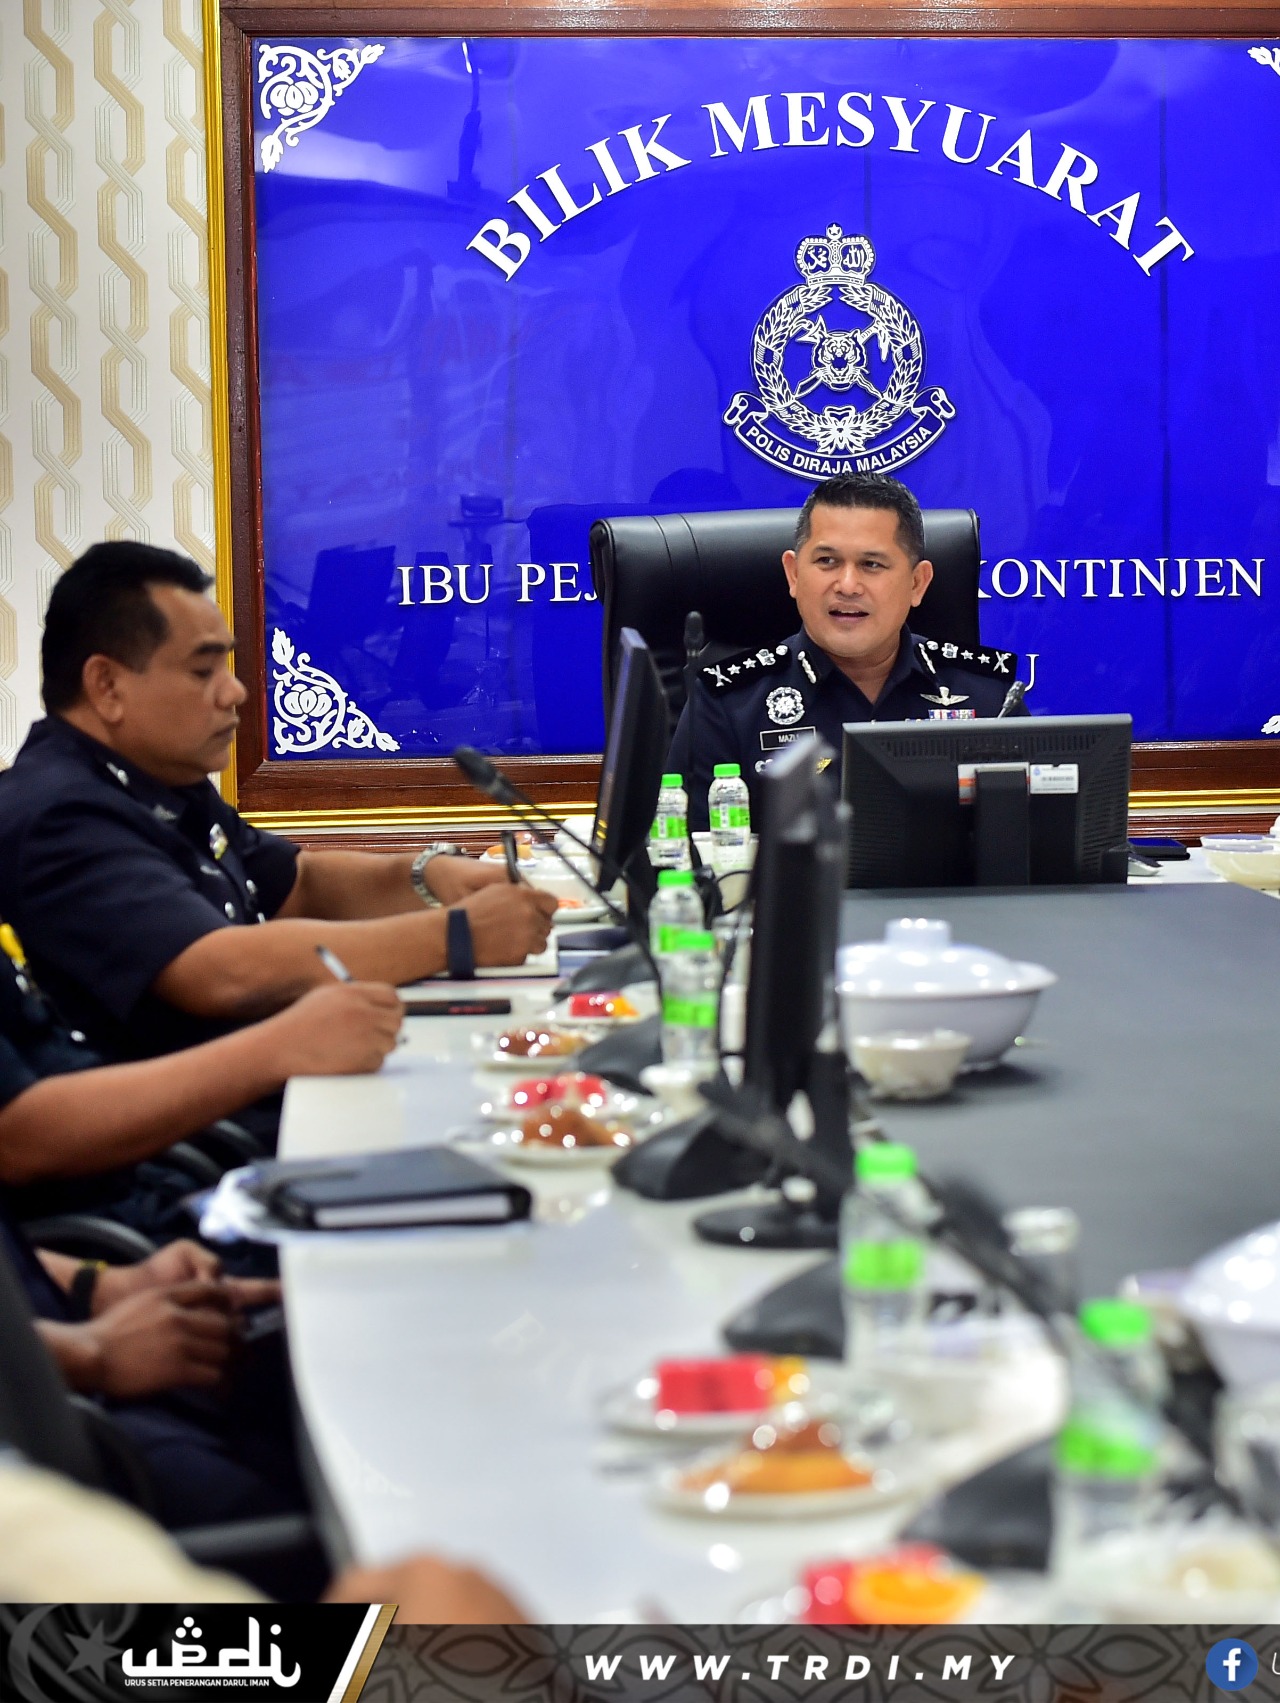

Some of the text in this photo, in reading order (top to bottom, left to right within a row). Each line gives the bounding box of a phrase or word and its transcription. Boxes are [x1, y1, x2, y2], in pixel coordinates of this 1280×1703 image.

[466, 92, 1195, 282] BILIK MESYUARAT
[746, 425, 932, 474] POLIS DIRAJA MALAYSIA
[397, 564, 494, 605] IBU
